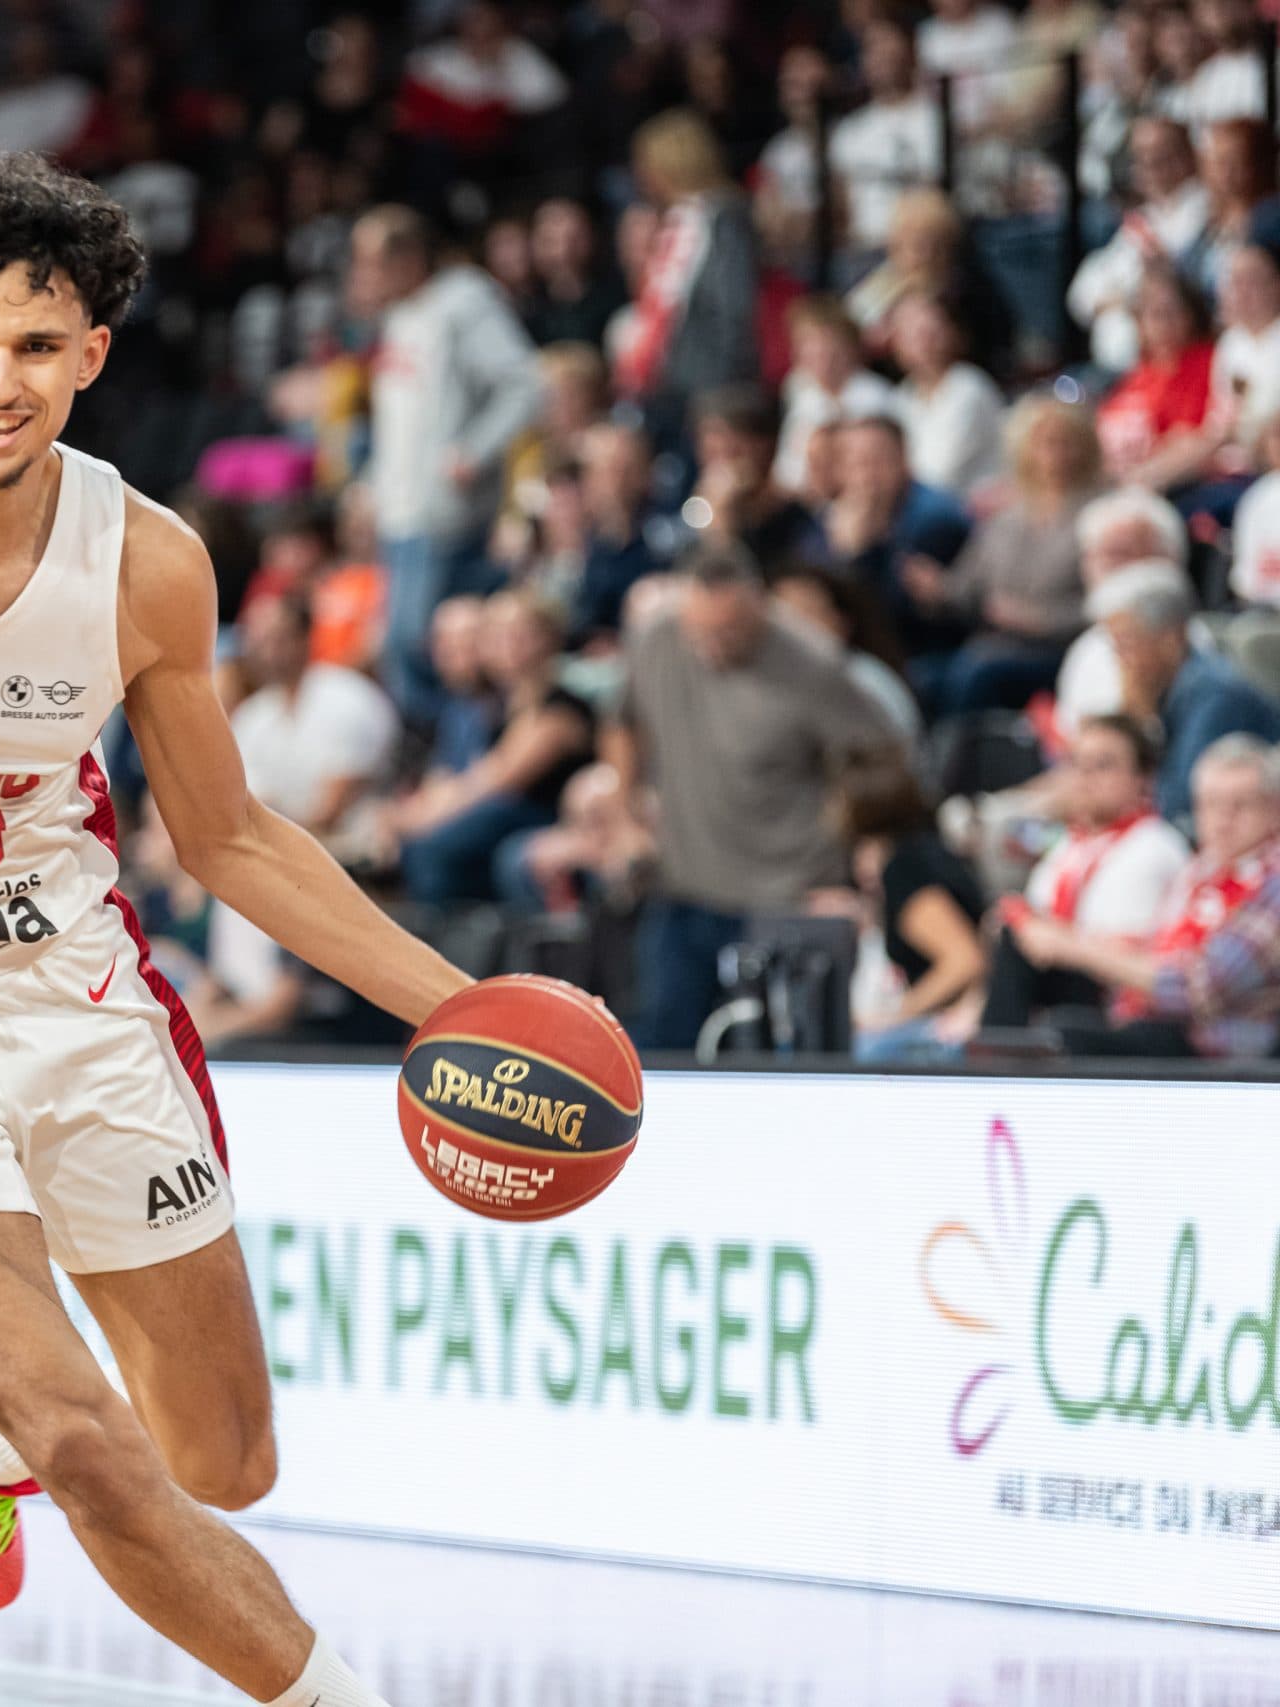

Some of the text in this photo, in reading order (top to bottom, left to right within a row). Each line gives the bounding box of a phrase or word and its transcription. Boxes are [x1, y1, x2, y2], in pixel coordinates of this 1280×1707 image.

[0, 710, 86, 720] BRESSE AUTO SPORT
[53, 689, 70, 697] MINI
[424, 1057, 587, 1149] SPALDING
[421, 1125, 555, 1188] LEGACY
[147, 1158, 216, 1221] AIN
[147, 1223, 161, 1231] le
[384, 1222, 819, 1428] PAYSAGER
